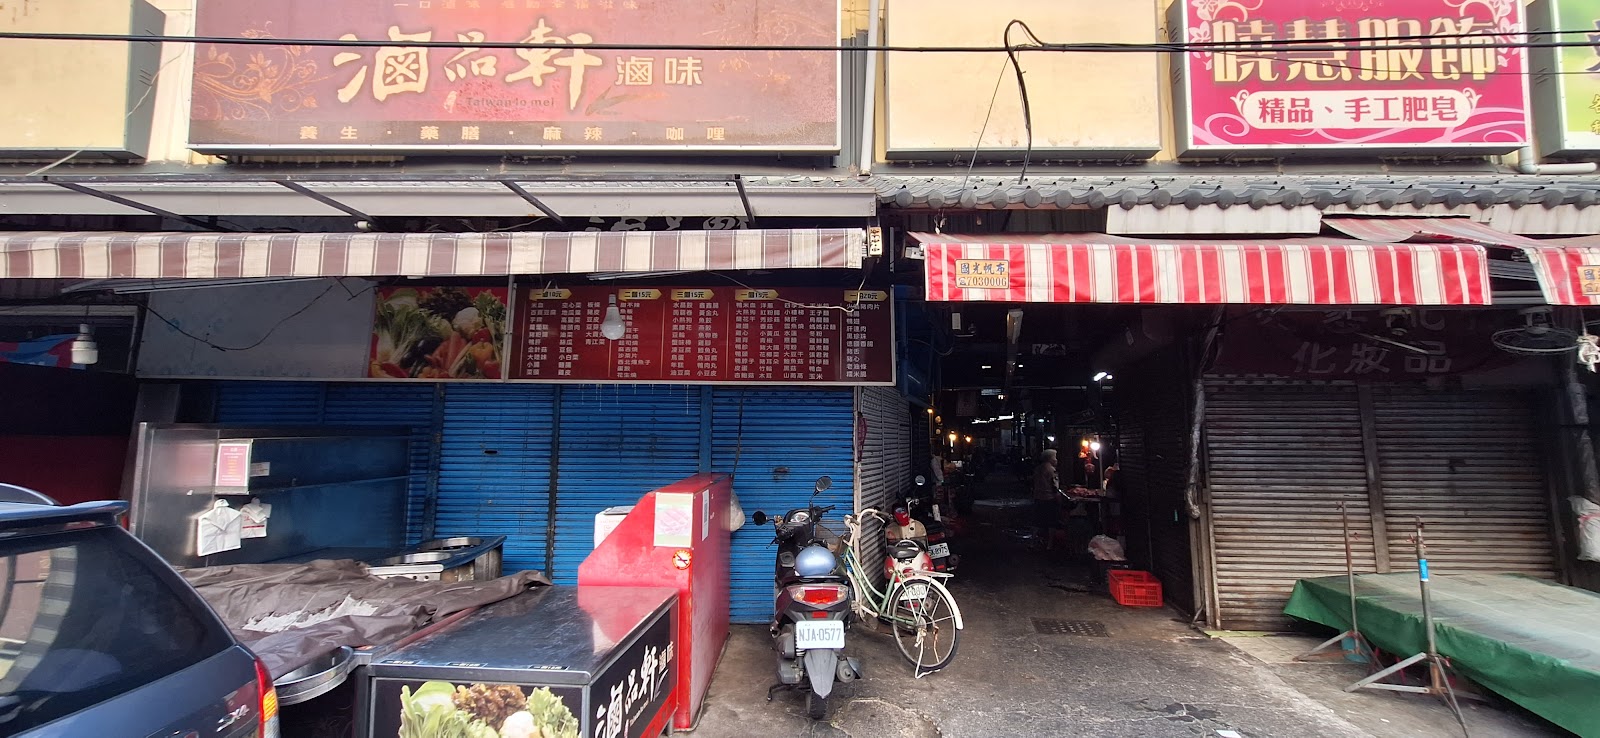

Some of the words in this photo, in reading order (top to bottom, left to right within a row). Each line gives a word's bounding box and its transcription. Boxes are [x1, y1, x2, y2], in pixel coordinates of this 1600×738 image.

[333, 18, 603, 111] 滷品軒
[615, 55, 703, 87] 滷味
[1258, 95, 1458, 124] 精品、手工肥皂
[960, 262, 1005, 275] 國光帆布
[1292, 340, 1452, 374] 化妝品
